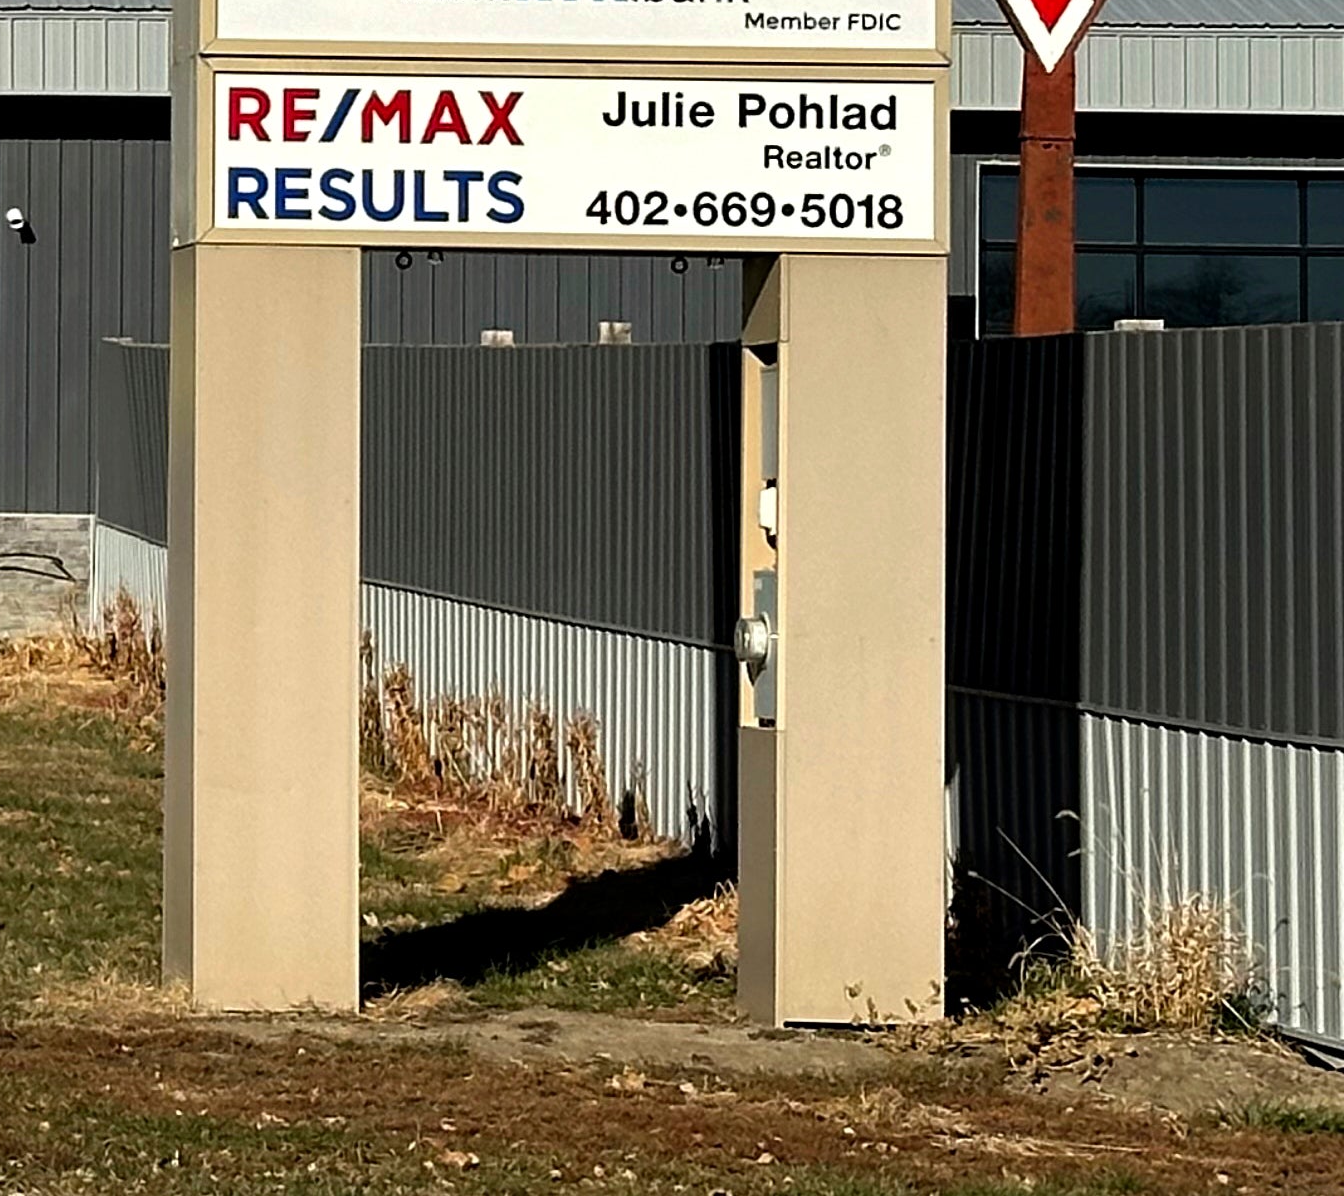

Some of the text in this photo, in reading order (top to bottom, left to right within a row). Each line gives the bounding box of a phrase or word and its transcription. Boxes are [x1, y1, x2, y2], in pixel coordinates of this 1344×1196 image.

[744, 12, 902, 32] Member FDIC
[227, 86, 526, 147] RE/MAX
[602, 91, 898, 131] Julie Pohlad
[227, 166, 526, 225] RESULTS
